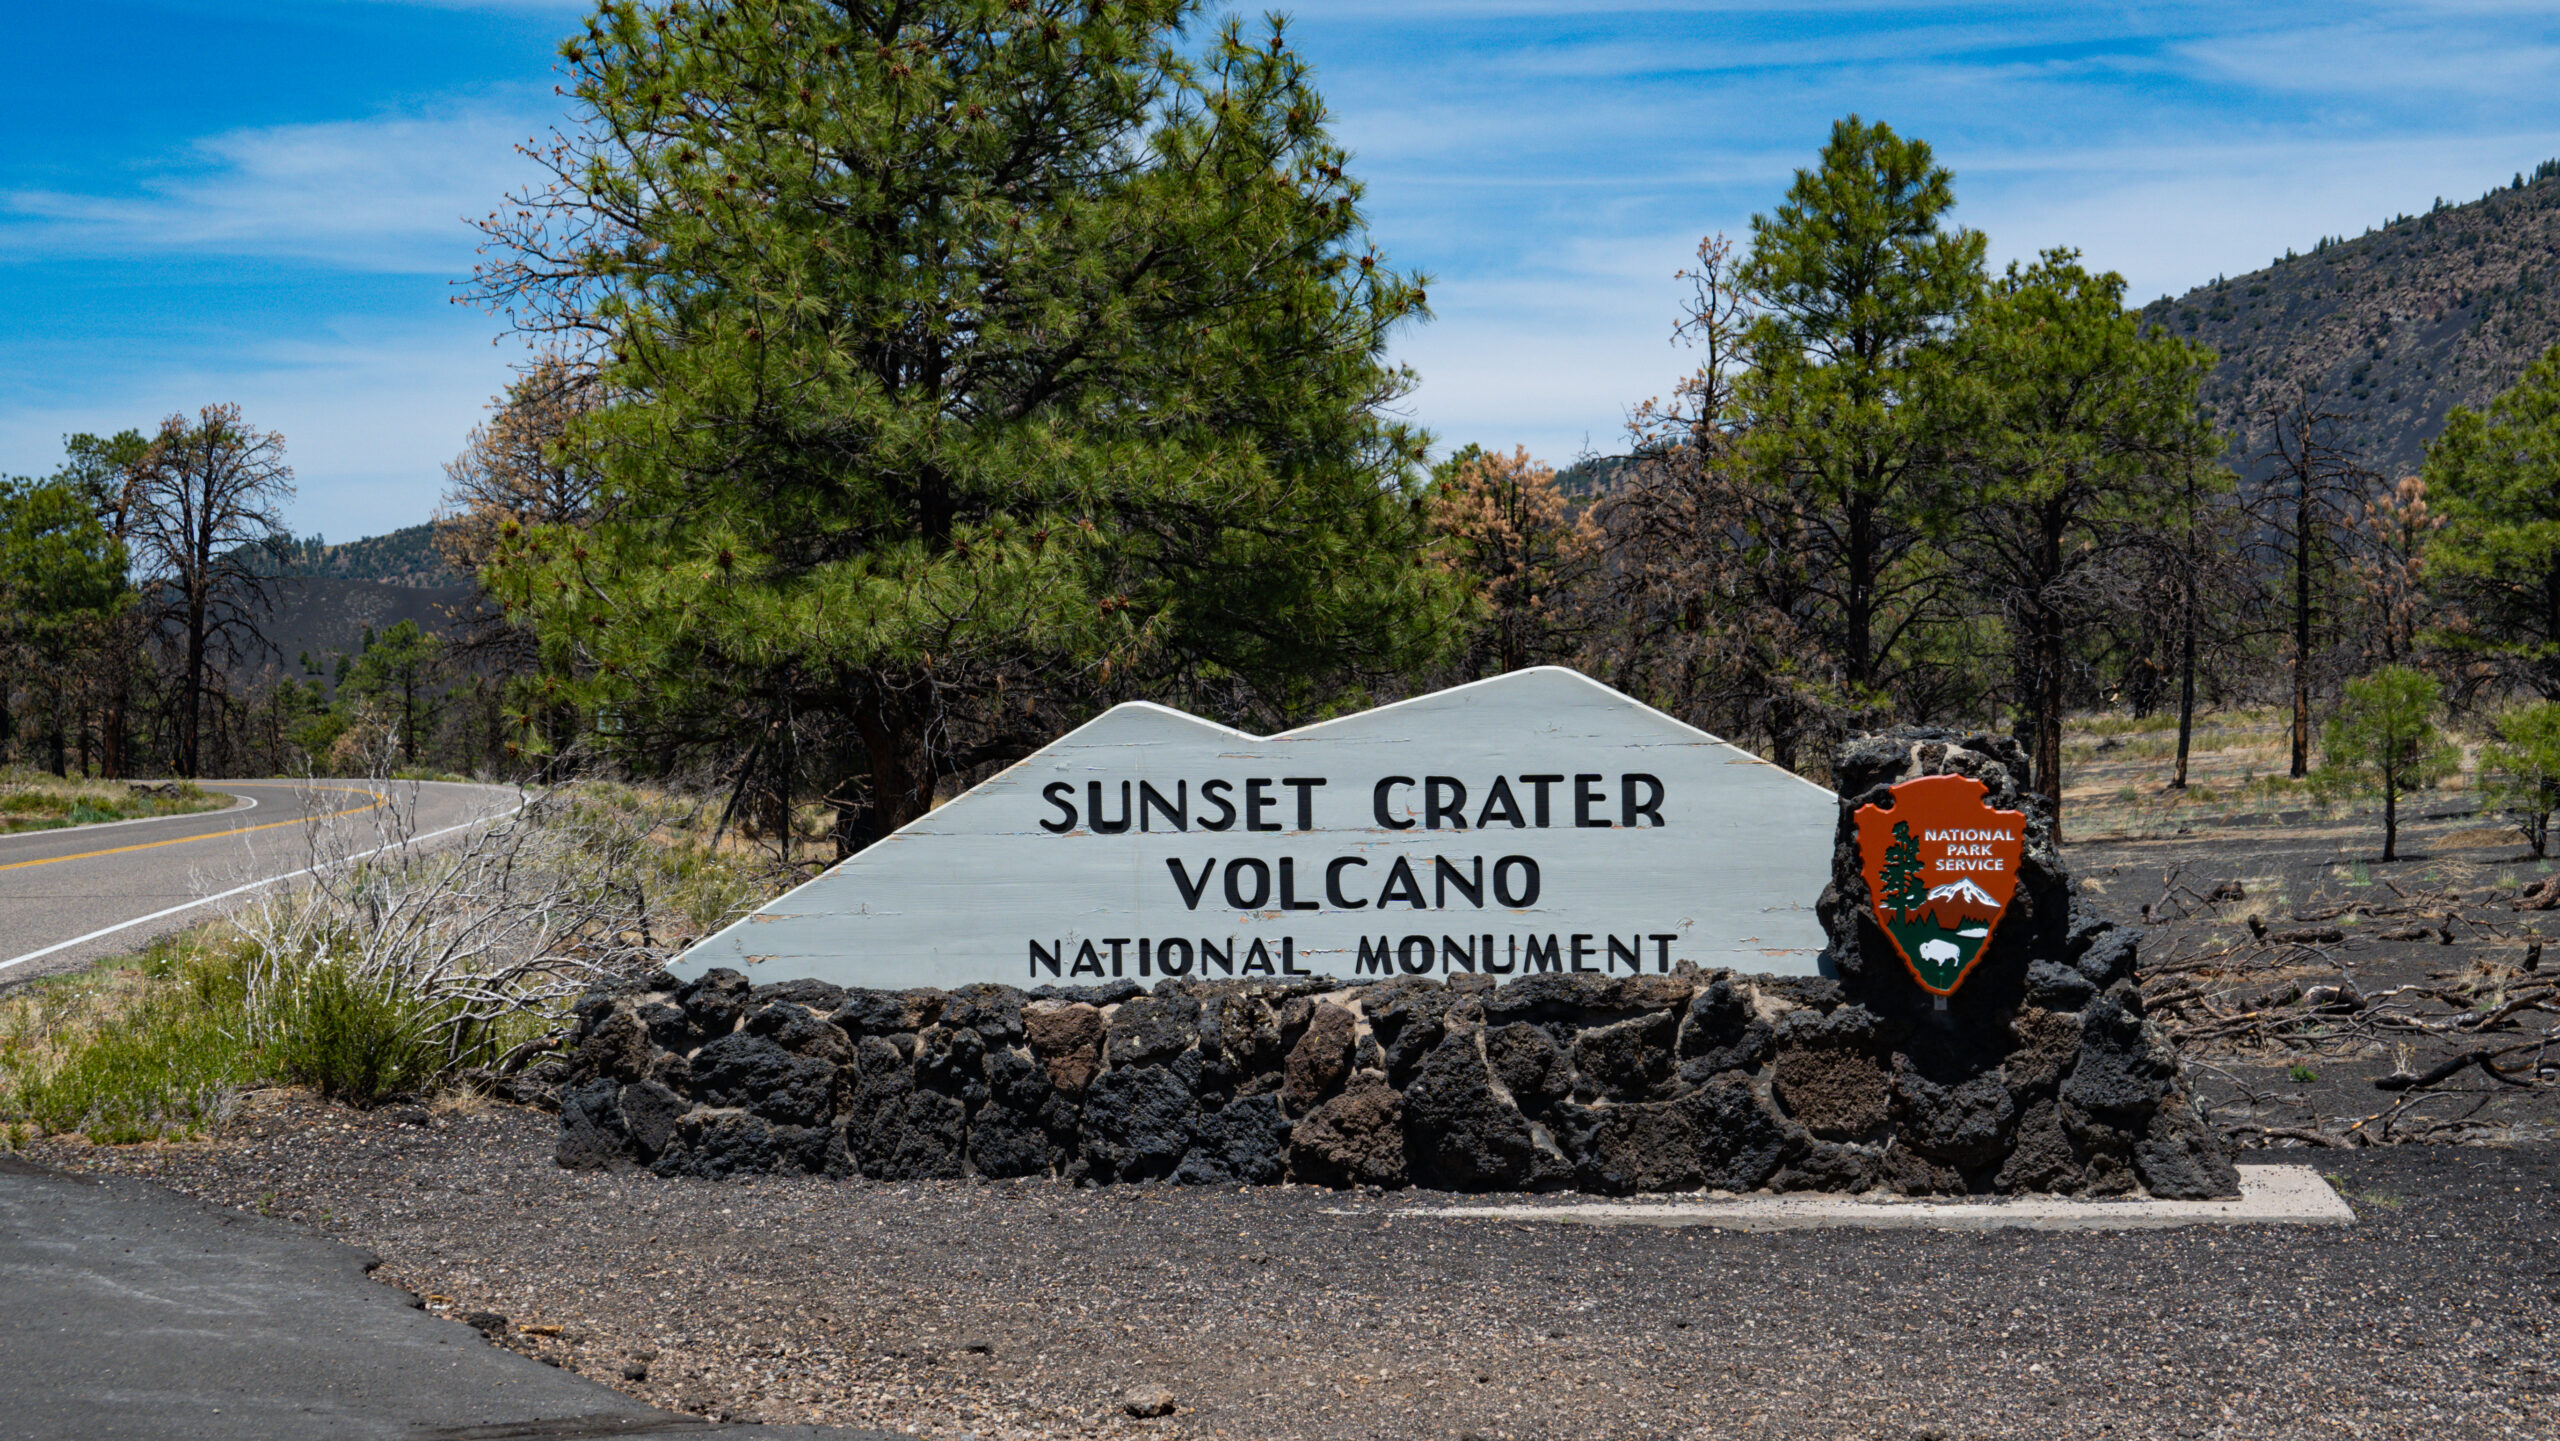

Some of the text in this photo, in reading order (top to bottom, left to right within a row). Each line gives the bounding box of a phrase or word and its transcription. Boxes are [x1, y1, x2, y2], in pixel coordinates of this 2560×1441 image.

[1039, 773, 1666, 834] SUNSET CRATER
[1924, 829, 2015, 841] NATIONAL
[1935, 858, 2004, 871] SERVICE
[1947, 844, 1993, 856] PARK
[1165, 854, 1541, 911] VOLCANO
[1028, 933, 1679, 978] NATIONAL MONUMENT
